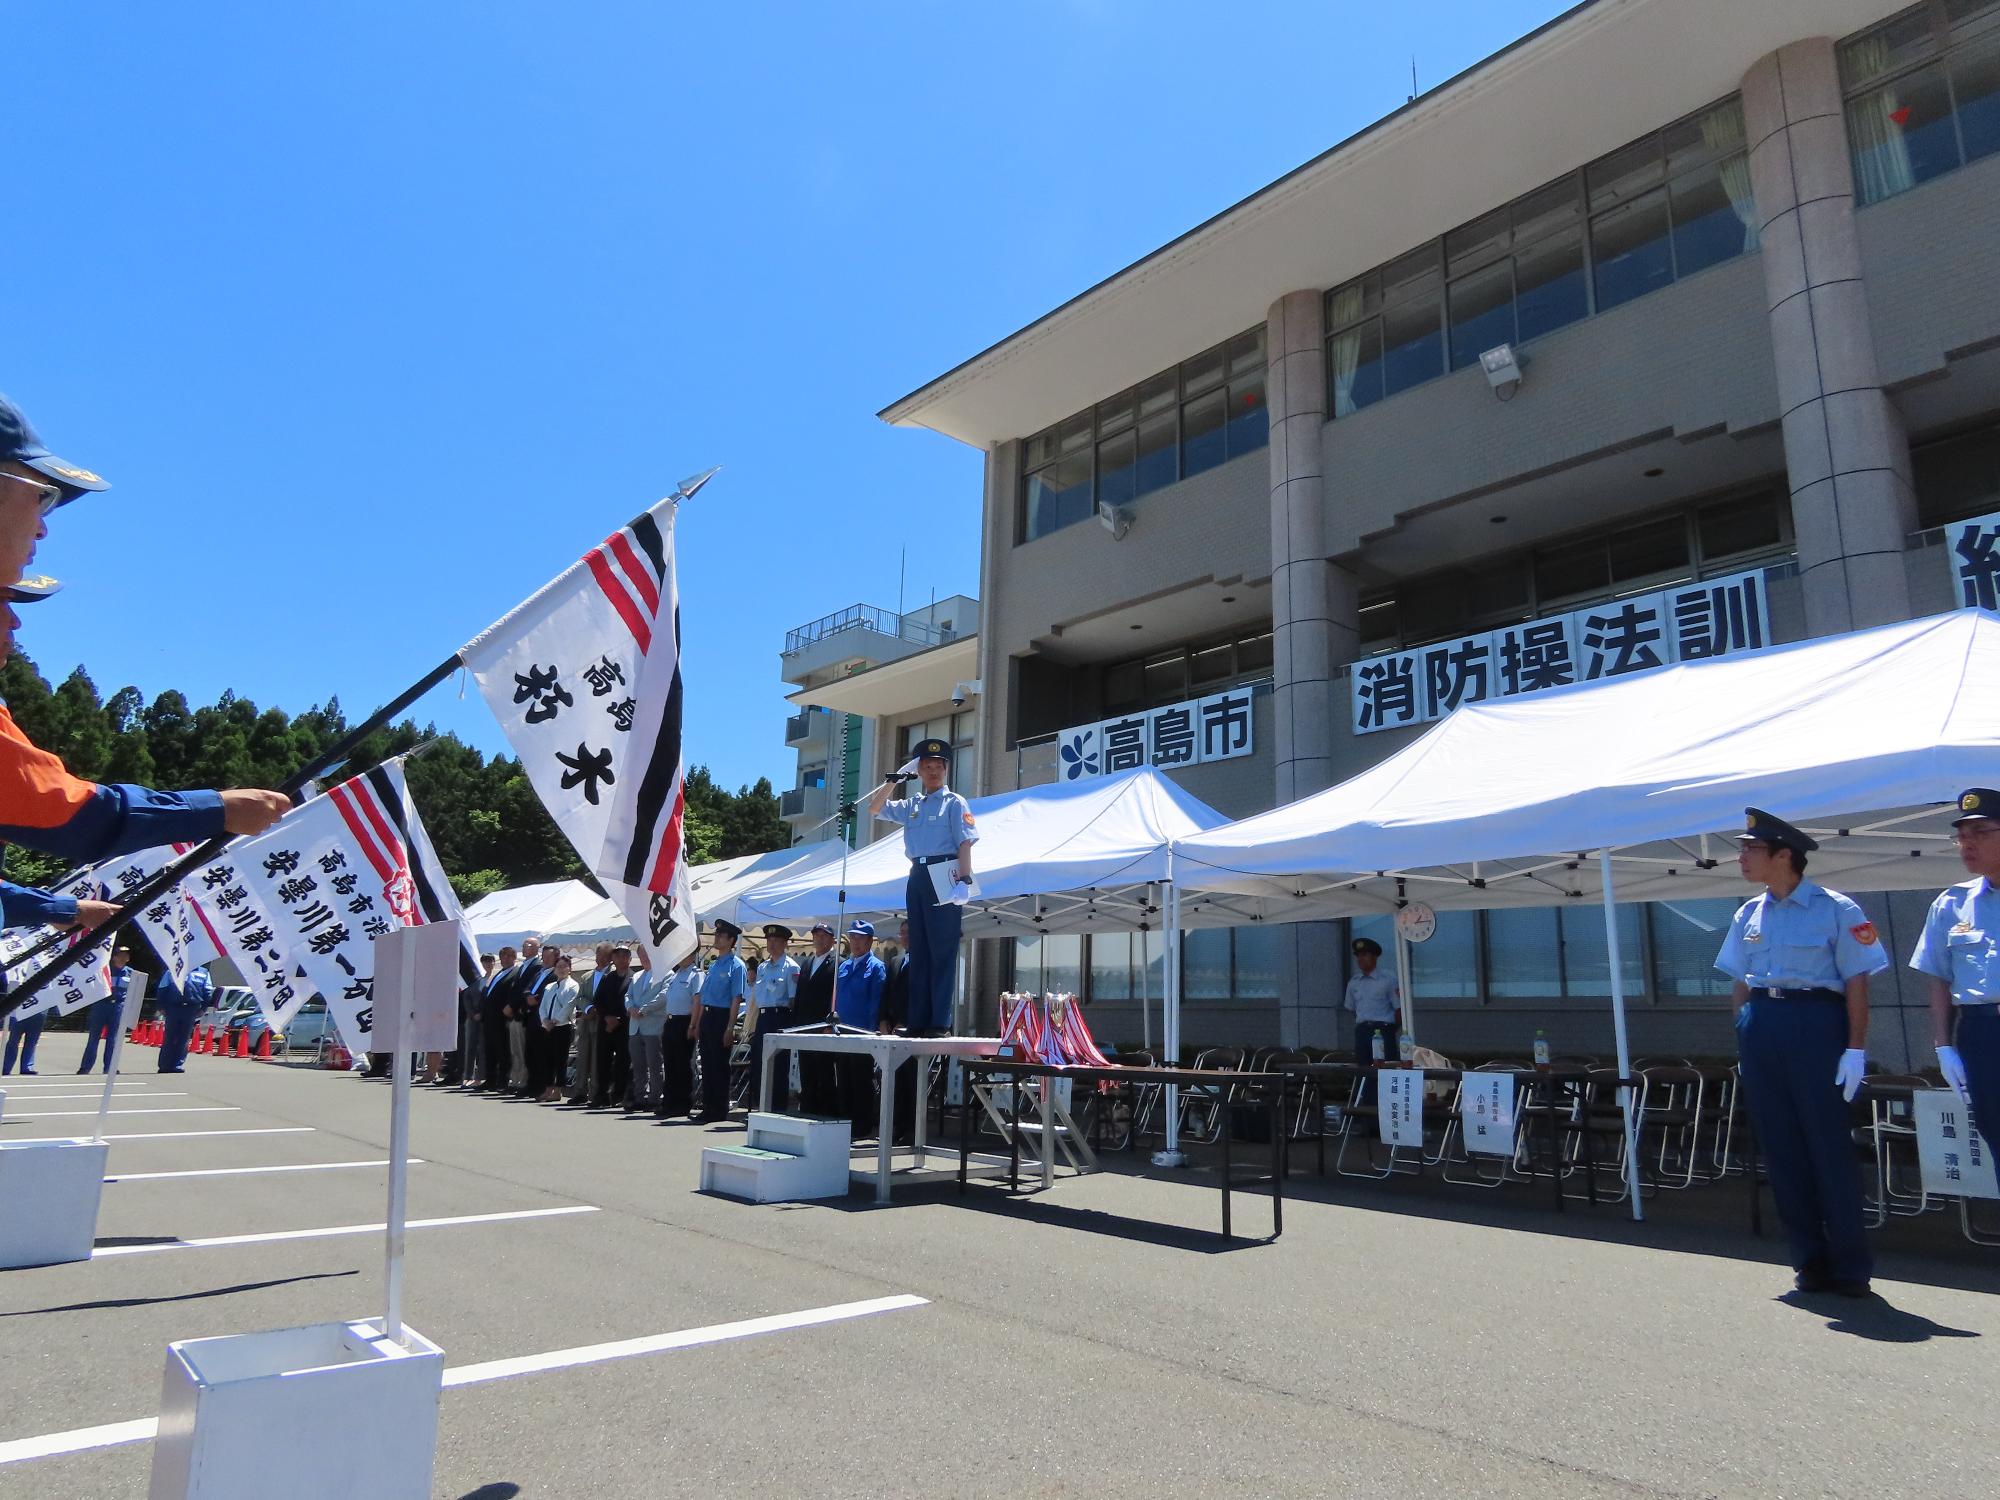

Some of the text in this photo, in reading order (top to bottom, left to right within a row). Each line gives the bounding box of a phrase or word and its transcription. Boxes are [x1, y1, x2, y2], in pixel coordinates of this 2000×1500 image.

[1104, 576, 1762, 774] 高島市 消防操法訓
